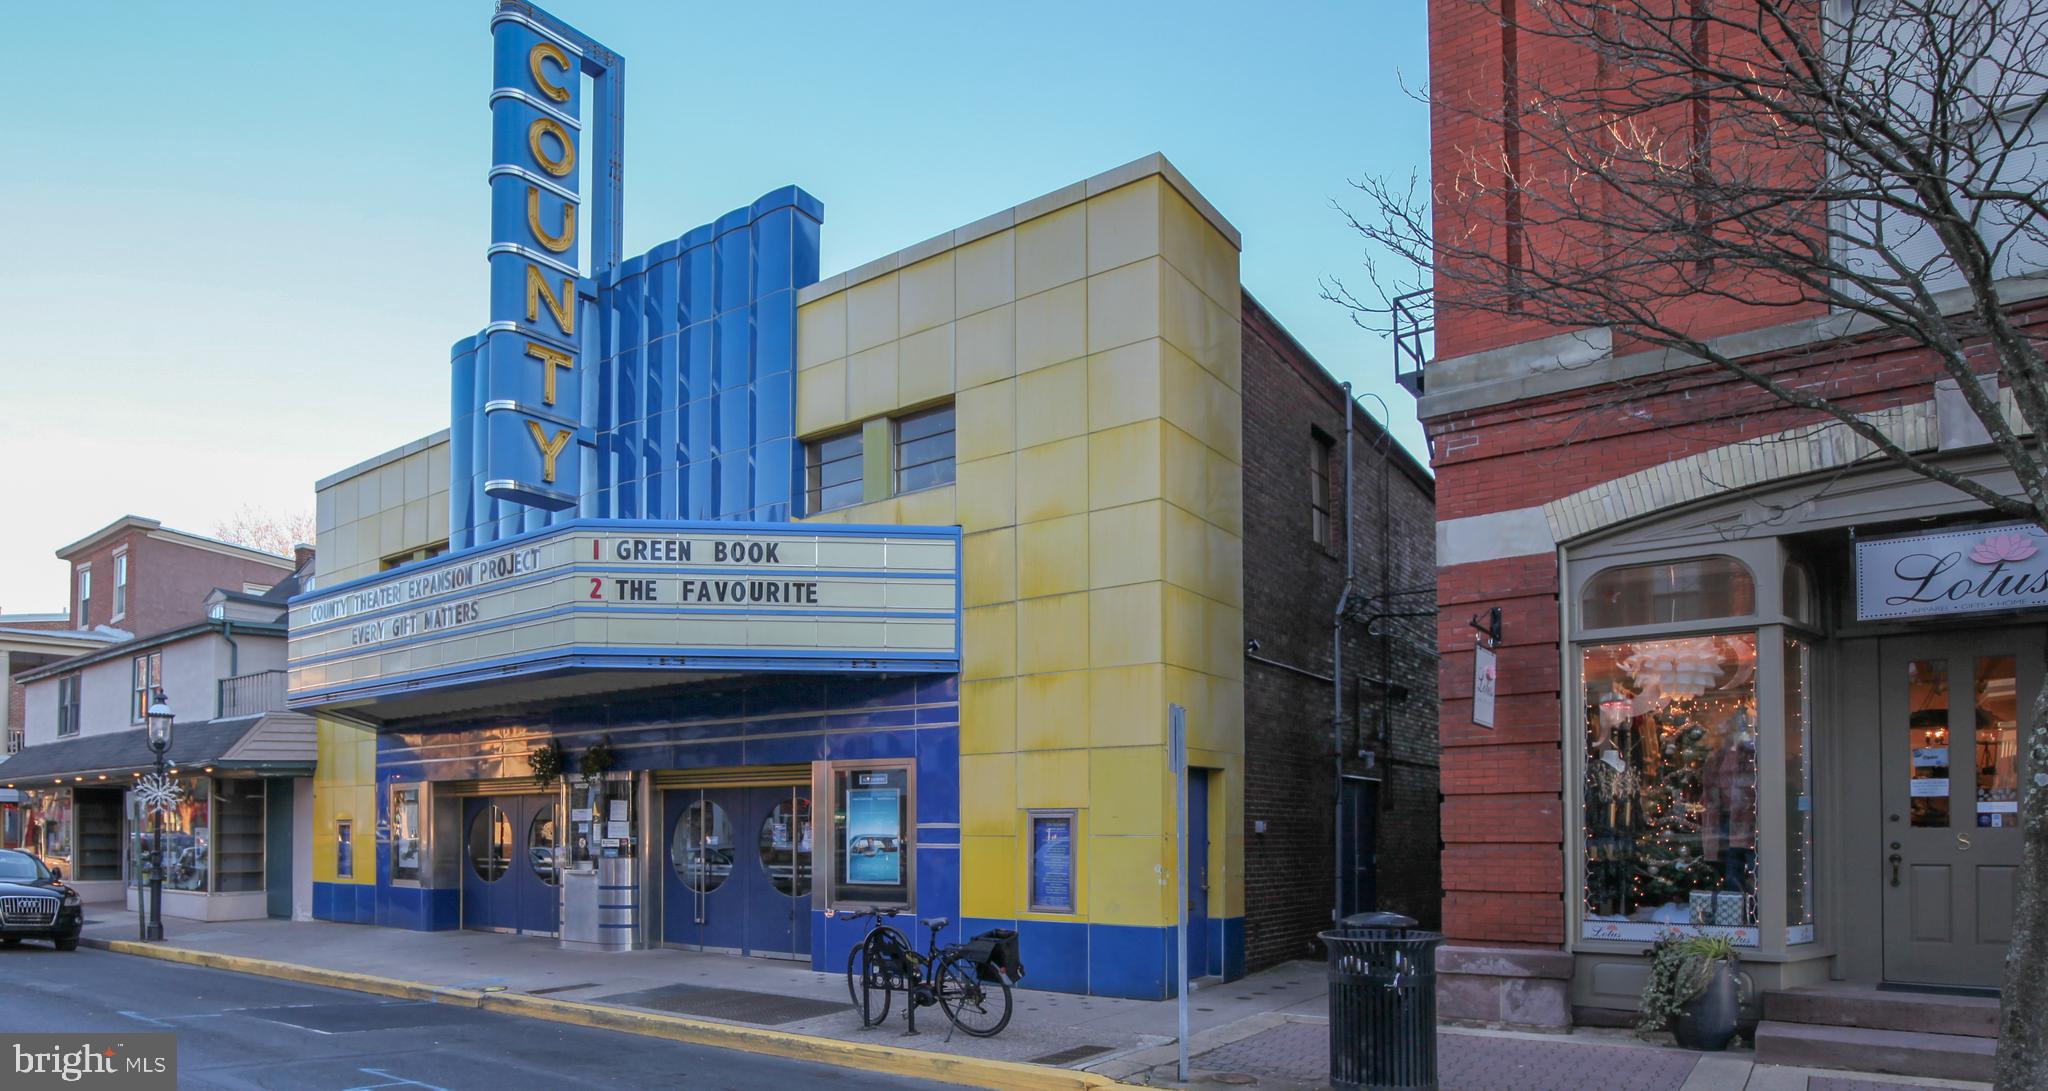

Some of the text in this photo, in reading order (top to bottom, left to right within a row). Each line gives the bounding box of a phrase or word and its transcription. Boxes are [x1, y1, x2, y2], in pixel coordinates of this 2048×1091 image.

[526, 42, 576, 484] COUNTY
[593, 539, 780, 563] 1 GREEN BOOK
[311, 548, 541, 622] COUNTY THEATER EXPANSION PROJECT
[590, 577, 818, 604] 2 THE FAVOURITE
[1885, 551, 2048, 606] Lotus
[352, 601, 479, 645] EVERY GIFT MATTERS
[1911, 598, 2026, 614] APPAREL GIFTS HOME
[1592, 927, 1622, 938] Lotus
